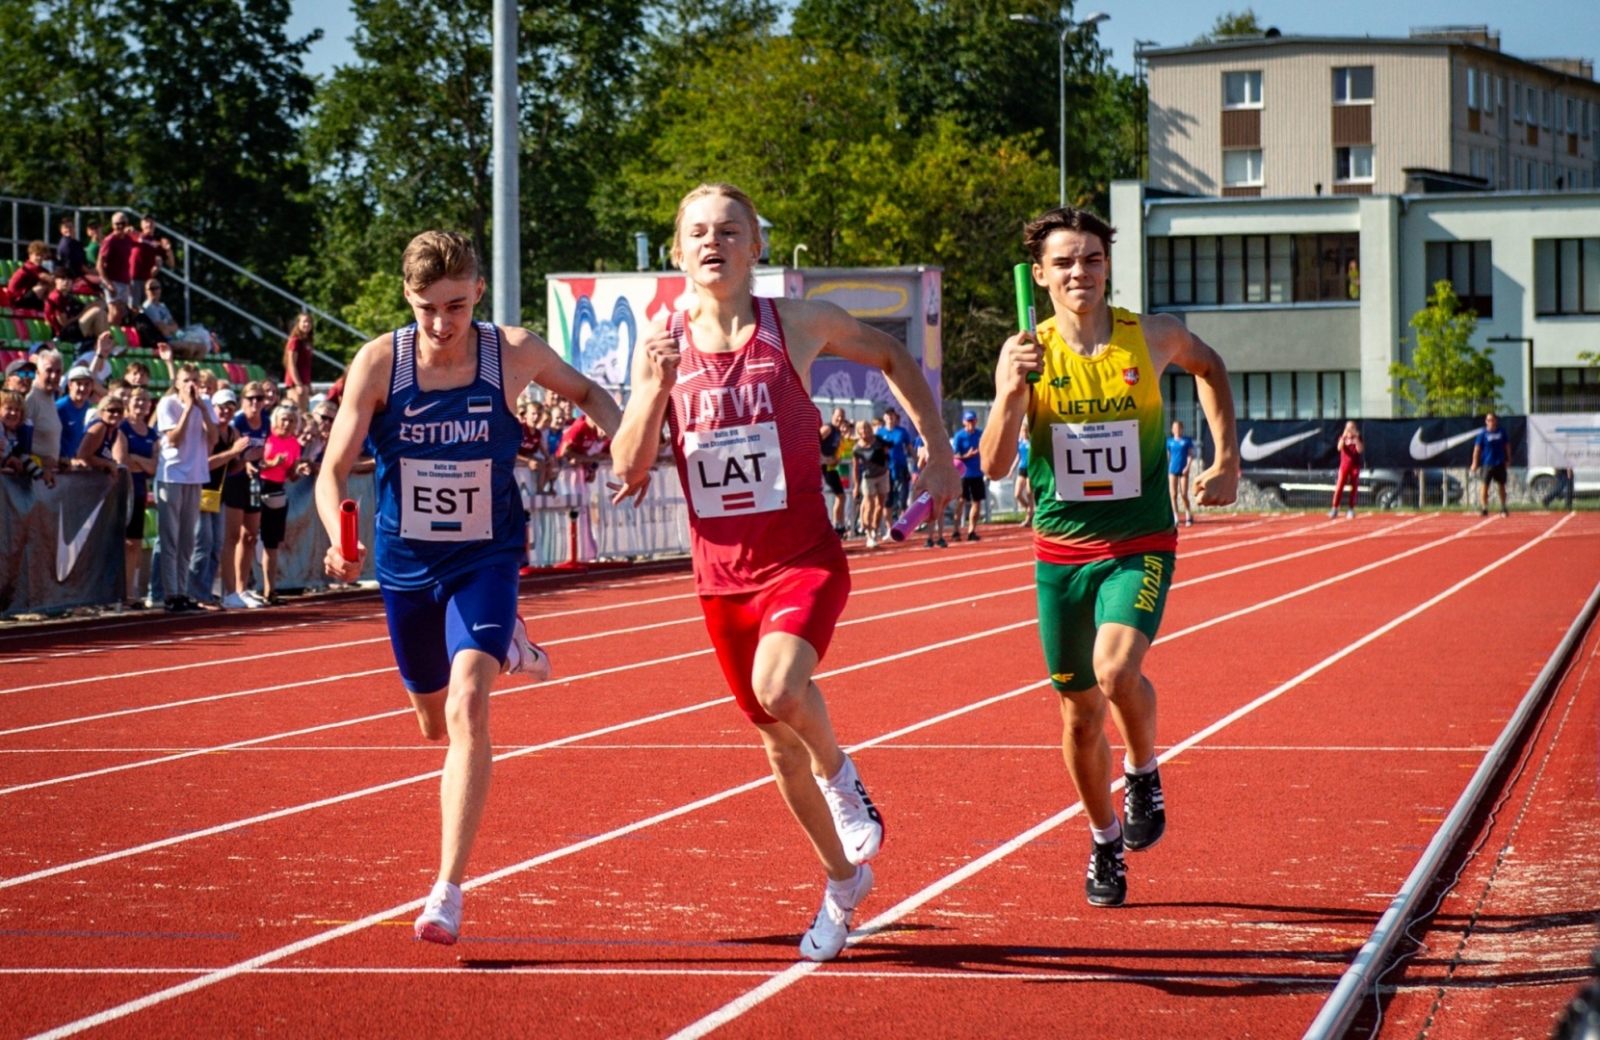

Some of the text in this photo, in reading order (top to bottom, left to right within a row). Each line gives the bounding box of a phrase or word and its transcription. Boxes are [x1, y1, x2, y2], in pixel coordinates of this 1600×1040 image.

[682, 382, 774, 424] LATVIA
[1057, 396, 1137, 415] LIETUVA
[400, 420, 489, 444] ESTONIA
[747, 434, 760, 442] 2022
[697, 452, 767, 488] LAT
[1066, 446, 1127, 474] LTU
[429, 471, 463, 479] Championships
[413, 486, 480, 515] EST
[1134, 555, 1163, 613] LIETUVA
